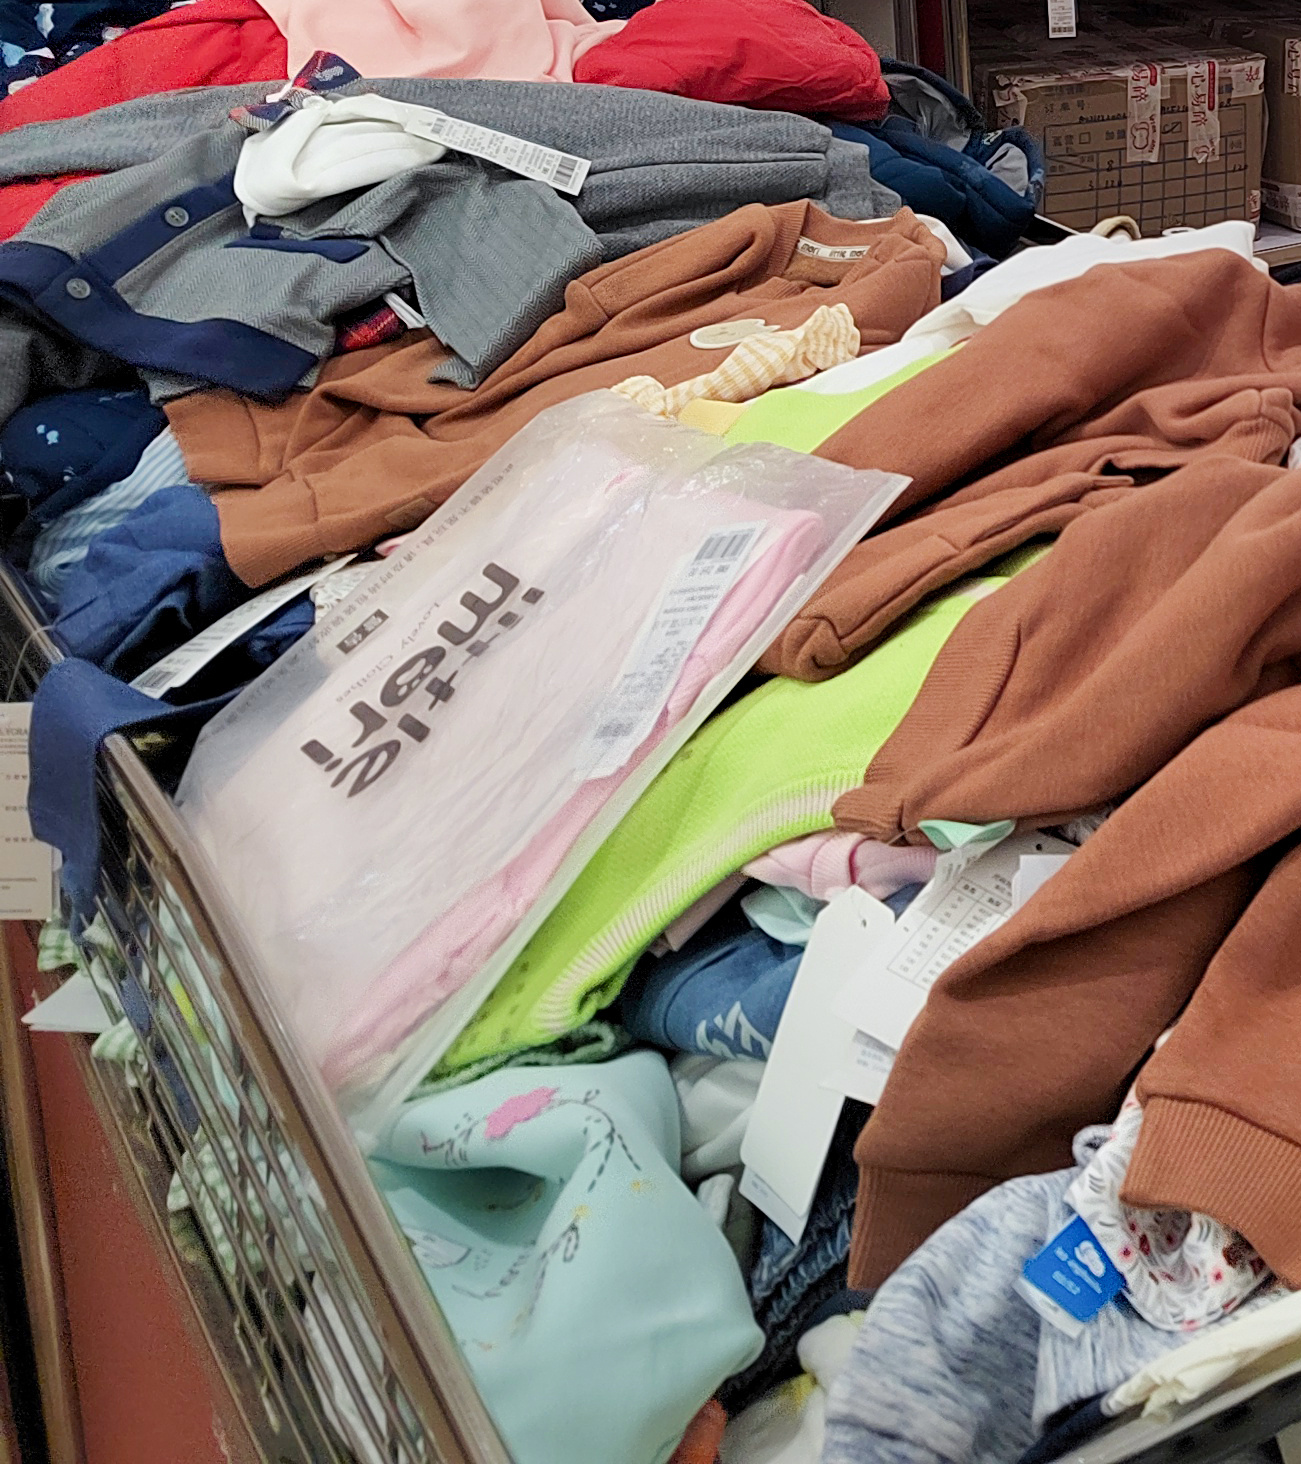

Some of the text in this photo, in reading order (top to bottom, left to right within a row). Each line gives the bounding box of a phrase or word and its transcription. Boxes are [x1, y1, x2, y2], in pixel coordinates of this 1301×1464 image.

[300, 561, 520, 772] mori
[330, 586, 545, 799] little
[335, 599, 442, 704] Lovely Clothes
